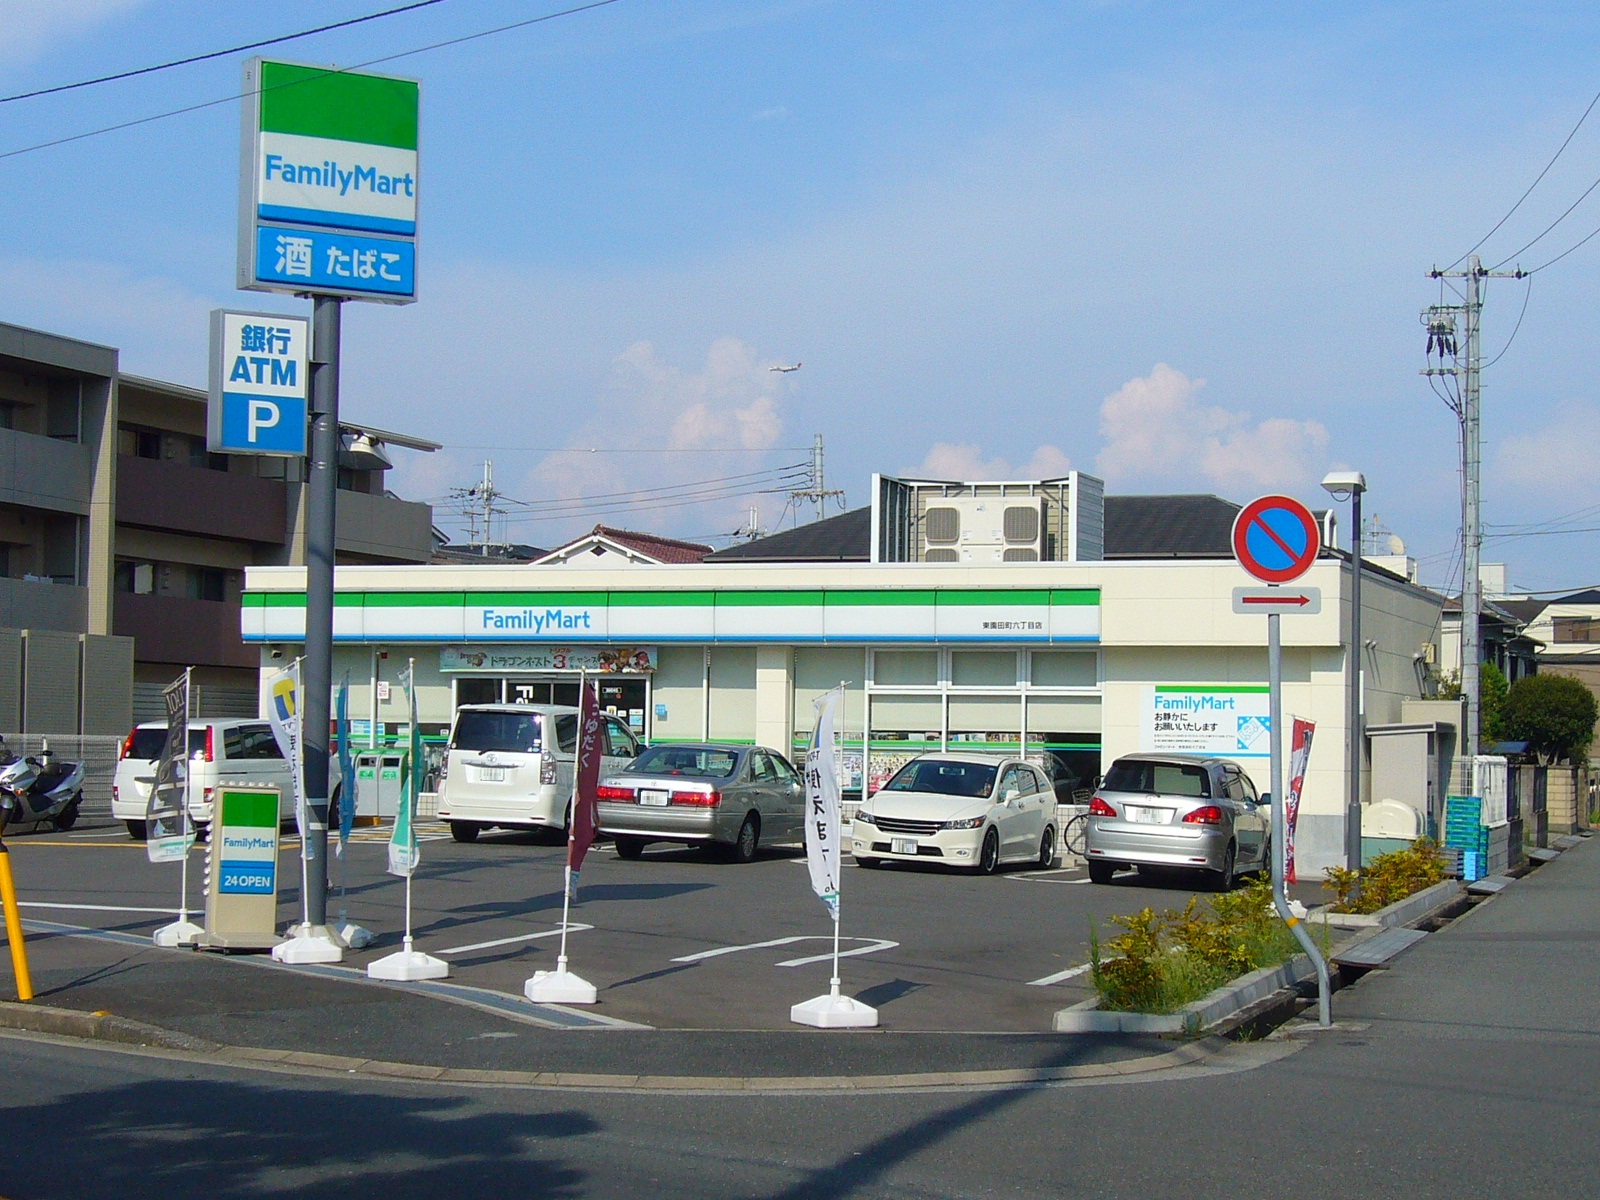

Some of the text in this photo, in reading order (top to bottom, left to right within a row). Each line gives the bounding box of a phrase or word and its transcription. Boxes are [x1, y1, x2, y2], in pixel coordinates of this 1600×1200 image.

[266, 154, 413, 197] FamilyMart
[275, 235, 401, 281] 酒 たばこ
[241, 324, 291, 355] 銀行
[229, 356, 297, 387] ATM
[247, 399, 280, 443] P
[483, 610, 590, 633] FamilyMart
[553, 654, 567, 669] 3
[1154, 695, 1235, 713] FamilyMart
[1154, 712, 1189, 721] お静かに
[1154, 722, 1218, 732] お願いいたします
[224, 837, 275, 849] FamilyMart
